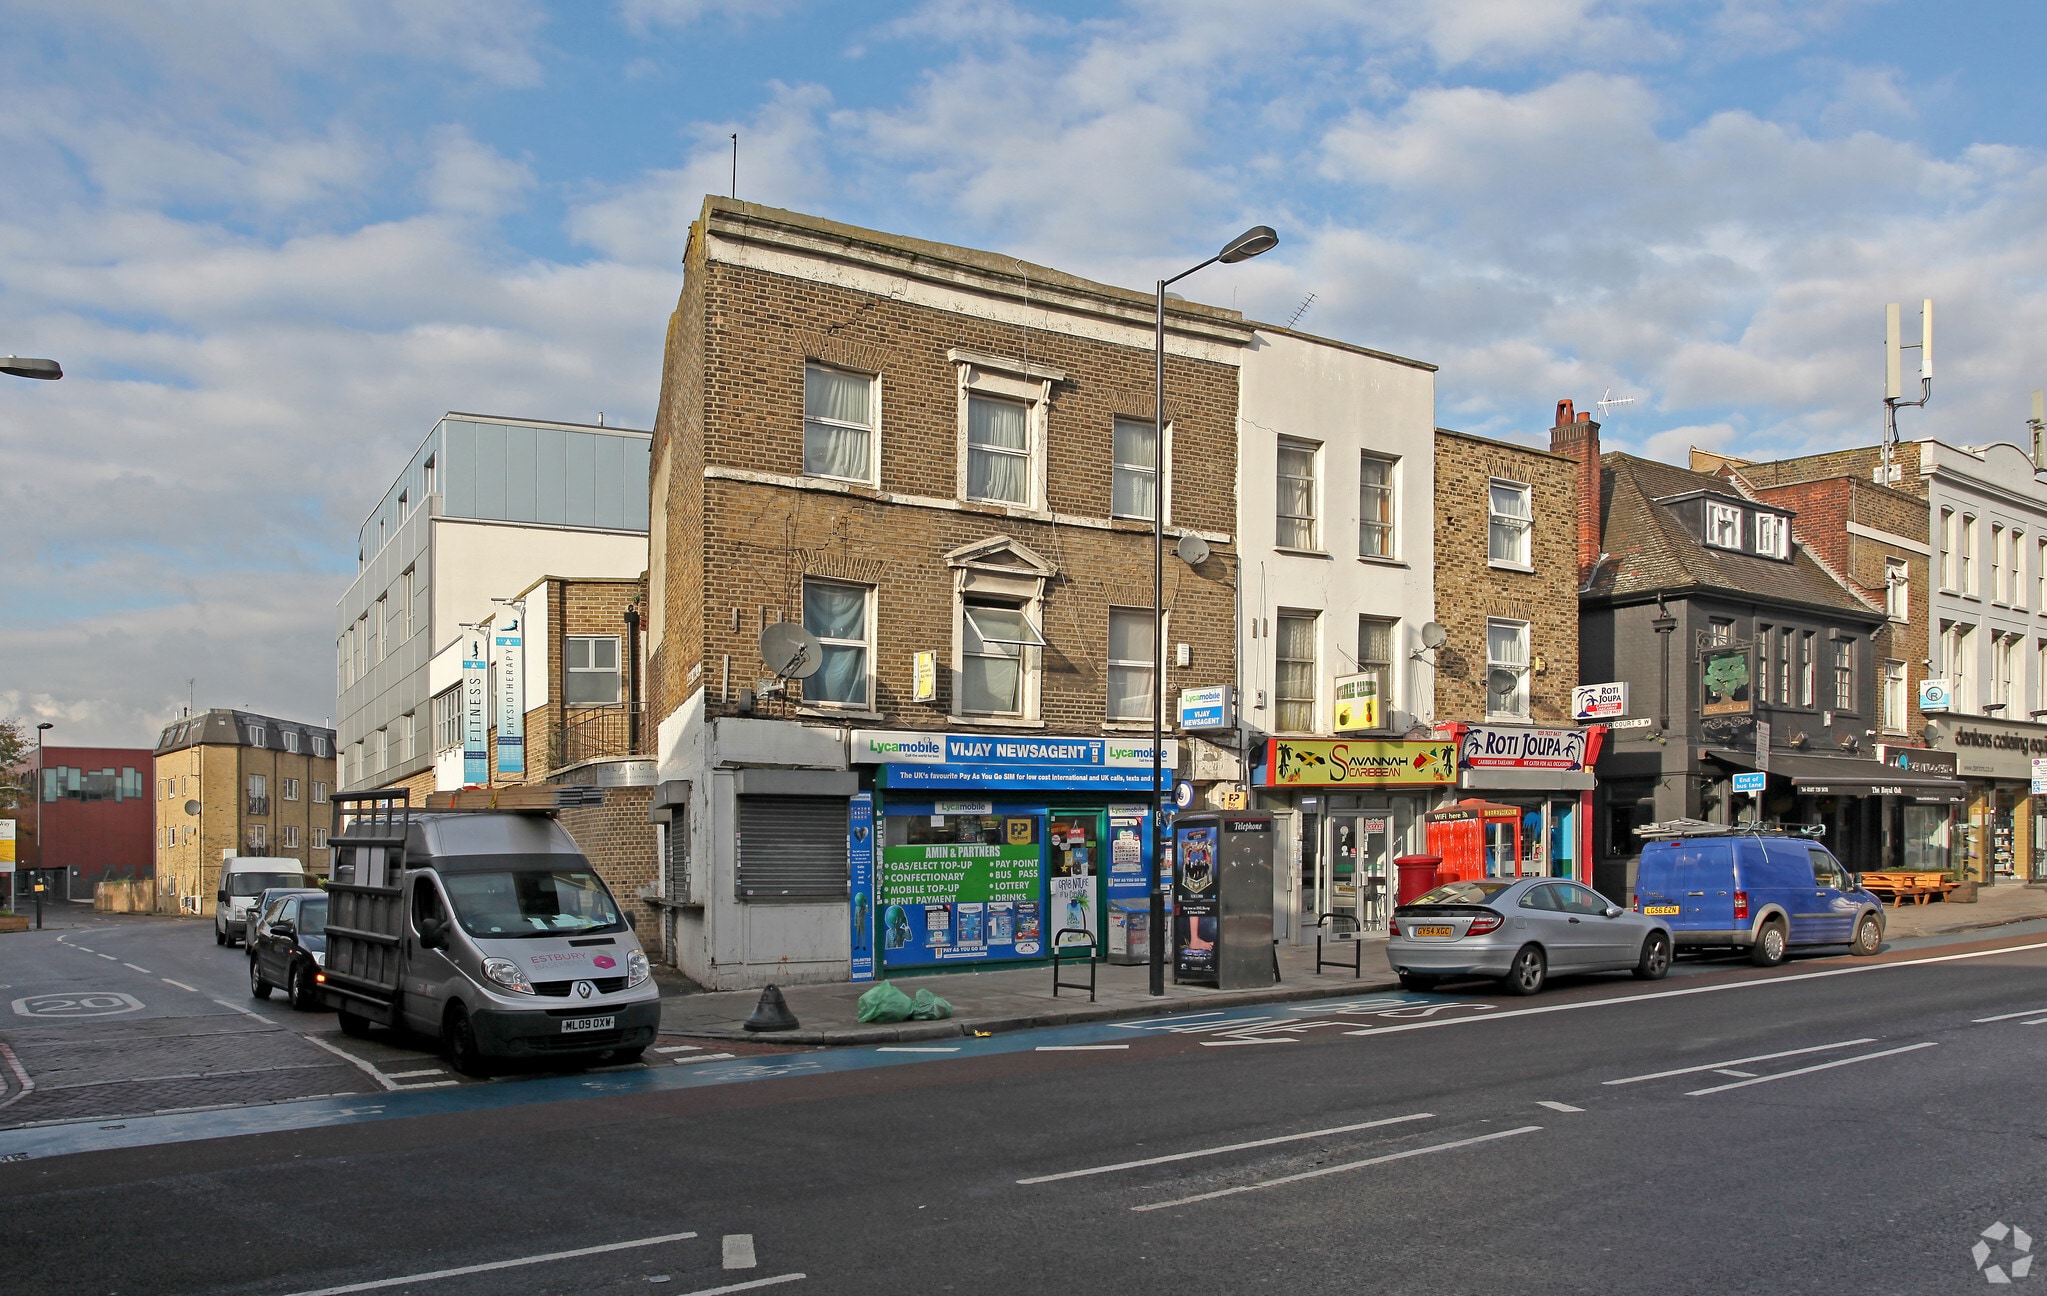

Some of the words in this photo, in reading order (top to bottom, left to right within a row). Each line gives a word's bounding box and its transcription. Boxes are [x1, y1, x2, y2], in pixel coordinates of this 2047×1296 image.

[506, 649, 515, 735] PHYSIOTHERAPY
[1602, 687, 1619, 695] ROTI
[1186, 692, 1220, 703] Lycamobile
[1599, 695, 1622, 703] JOUPA
[469, 678, 481, 742] FITNESS
[1194, 710, 1211, 718] VIJAY
[1184, 718, 1220, 726] NEWSAGENT
[1614, 720, 1635, 728] COURT
[870, 739, 939, 754] Lycamobile
[1485, 731, 1519, 755] ROTI
[1520, 733, 1561, 759] JOUPA
[1993, 730, 2029, 757] catering
[951, 742, 993, 757] VIJAY
[997, 743, 1087, 759] NEWSAGENT
[1329, 744, 1408, 782] SAVANNAH
[900, 771, 912, 779] The
[913, 771, 929, 779] UK's
[959, 772, 971, 781] Pay
[972, 772, 980, 780] As
[981, 772, 993, 780] You
[1349, 767, 1401, 777] CARIBBEAN
[1872, 786, 1880, 794] The
[1881, 786, 1893, 795] Royal
[941, 802, 986, 812] Lycamobile
[1234, 821, 1263, 831] Telephone
[925, 847, 949, 859] AMIN
[949, 847, 957, 858] &
[958, 846, 1001, 858] PARTNERS
[890, 862, 938, 871] GAS/ELECT
[940, 861, 973, 870] TOP-UP
[995, 860, 1011, 868] PAY
[1012, 859, 1039, 868] POINT
[890, 872, 965, 882] CONFECTIONARY
[995, 870, 1012, 879] BUS
[1018, 869, 1039, 878] PASS
[890, 885, 925, 894] MOBILE
[927, 883, 960, 892] TOP-UP
[995, 881, 1030, 890] LOTTERY
[890, 897, 917, 905] RENT
[917, 895, 957, 903] PAYMENT
[995, 893, 1027, 901] DRINKS
[1646, 906, 1662, 914] LG56
[988, 917, 997, 937] 1
[1417, 927, 1434, 935] GY54
[1436, 927, 1450, 935] XGC
[530, 952, 586, 964] ESTBURY
[32, 997, 125, 1012] 20
[1288, 998, 1498, 1018] BUS
[565, 1020, 591, 1031] ML09
